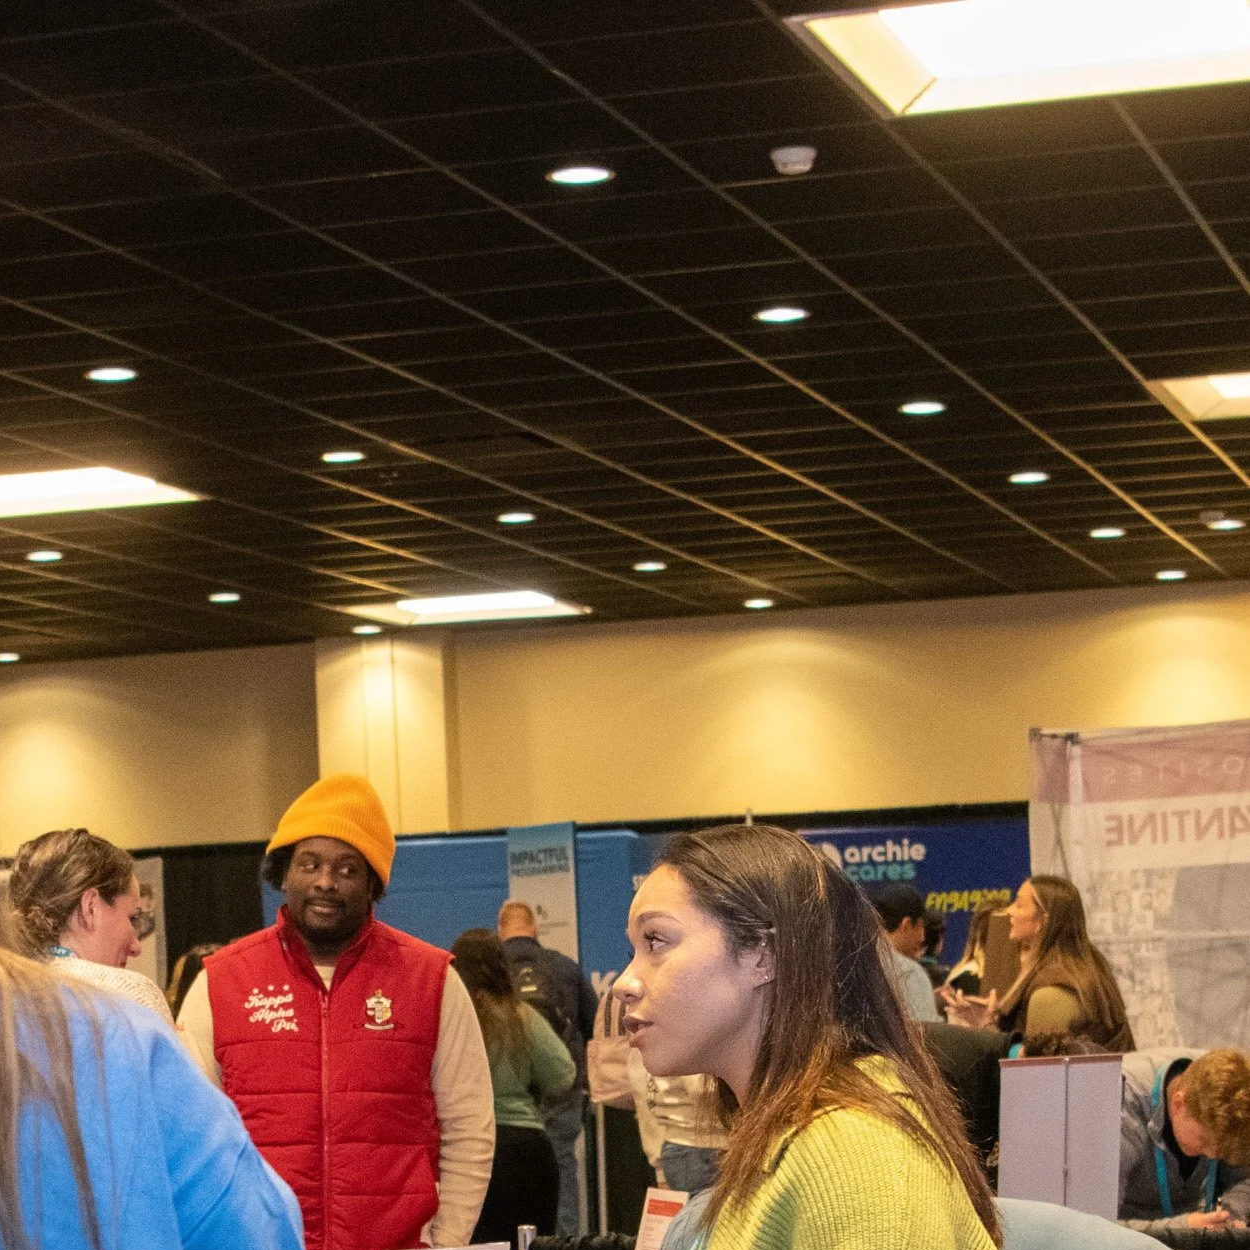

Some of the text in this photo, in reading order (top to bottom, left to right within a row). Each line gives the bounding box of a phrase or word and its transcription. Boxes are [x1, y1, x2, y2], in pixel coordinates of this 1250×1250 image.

[844, 838, 926, 863] archie
[846, 863, 916, 881] cares
[245, 993, 294, 1009] Kappa
[250, 1007, 295, 1024] Alpha
